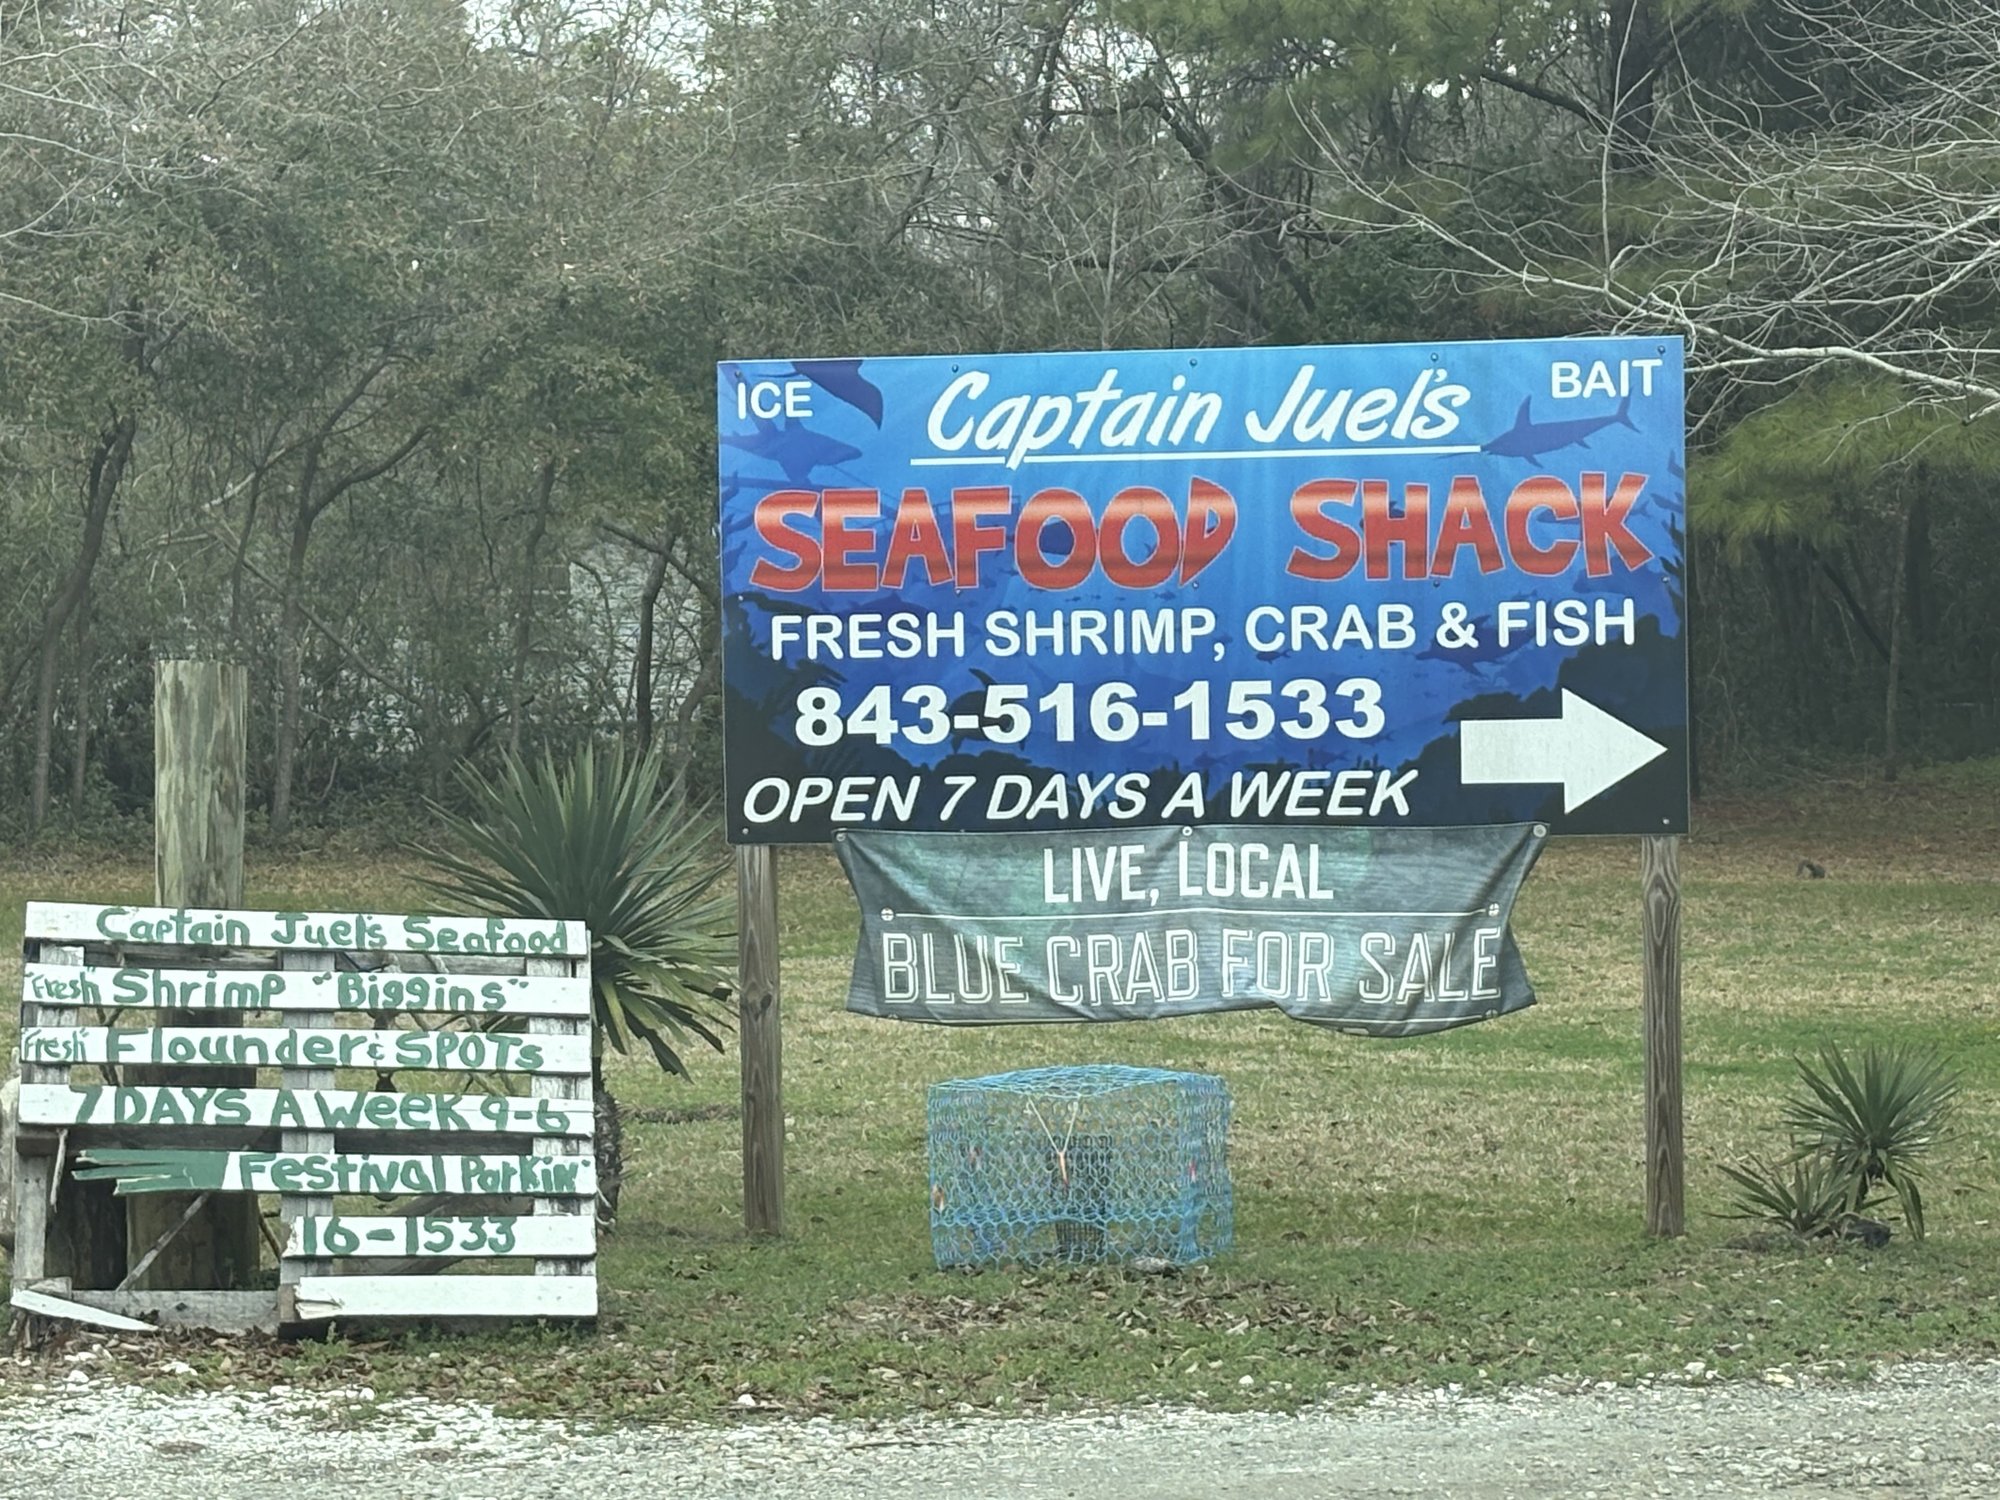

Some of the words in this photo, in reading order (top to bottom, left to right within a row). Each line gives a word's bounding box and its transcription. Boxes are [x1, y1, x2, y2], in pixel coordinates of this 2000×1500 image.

[738, 381, 813, 419] ICE
[1551, 359, 1663, 398] BAIT
[927, 369, 1222, 470] Captain
[1245, 364, 1471, 443] Juel's
[750, 475, 1238, 592] SEAFOOD
[1286, 471, 1654, 581] SHACK
[771, 611, 965, 660] FRESH
[984, 608, 1225, 661] SHRIMP,
[1245, 604, 1416, 652] CRAB
[1436, 602, 1479, 649] &
[1499, 598, 1635, 646] FISH
[795, 677, 1386, 746] 843-516-1533
[743, 775, 921, 823] OPEN
[940, 775, 976, 820] 7
[986, 772, 1150, 820] DAYS
[1161, 772, 1204, 818] A
[1230, 769, 1419, 818] WEEK
[1043, 844, 1160, 906] LIVE,
[1179, 842, 1334, 900] LOCAL
[97, 907, 250, 945] Captain
[271, 911, 388, 950] Juel's
[402, 915, 568, 954] Seafood
[881, 932, 1029, 1004] BLUE
[1045, 929, 1199, 1006] CRAB
[1221, 930, 1332, 1002] FOR
[1358, 926, 1501, 1002] SALE
[312, 972, 529, 1011] "Biggins"
[106, 1028, 367, 1065] Flounder
[70, 1084, 103, 1124] 7
[115, 1087, 251, 1125] DAYS
[271, 1089, 306, 1127] A
[480, 1096, 570, 1133] 9-6
[239, 1151, 447, 1193] Festival
[303, 1216, 517, 1255] 16-1533
